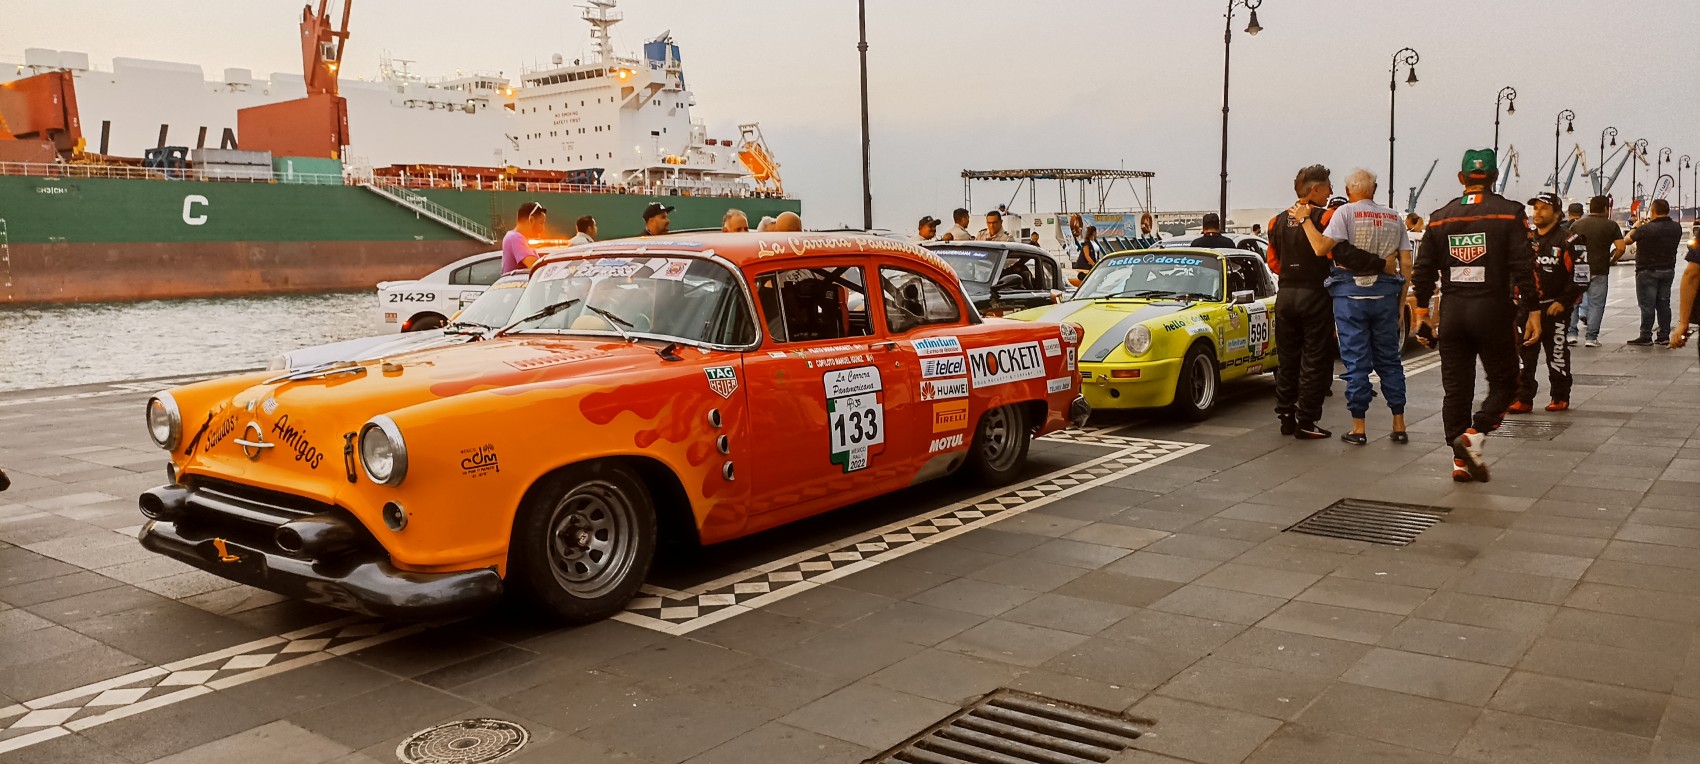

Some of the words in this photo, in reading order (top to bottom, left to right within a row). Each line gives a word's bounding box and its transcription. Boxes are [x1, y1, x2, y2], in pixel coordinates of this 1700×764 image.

[182, 194, 209, 225] C
[758, 240, 785, 258] La
[788, 236, 851, 256] Carrera
[1452, 234, 1482, 246] TAG
[1108, 258, 1140, 266] hello
[1155, 256, 1203, 266] doctor
[1452, 246, 1484, 262] HEUER
[389, 293, 436, 302] 21429
[1163, 320, 1186, 332] hello
[1251, 322, 1267, 342] 596
[915, 338, 958, 349] infinitum
[936, 358, 963, 374] telcel
[970, 345, 1041, 378] MOCKETT
[706, 367, 734, 379] TAG
[836, 372, 845, 382] La
[848, 370, 870, 382] Carrera
[710, 379, 738, 398] HEUER
[833, 383, 874, 395] Panamericana
[937, 384, 968, 396] HUAWEI
[935, 408, 966, 424] PIRELLI
[834, 408, 878, 446] 133
[272, 414, 324, 469] Amigos
[928, 433, 964, 453] MOTUL
[852, 446, 866, 454] MEXICO
[850, 459, 865, 469] 2022
